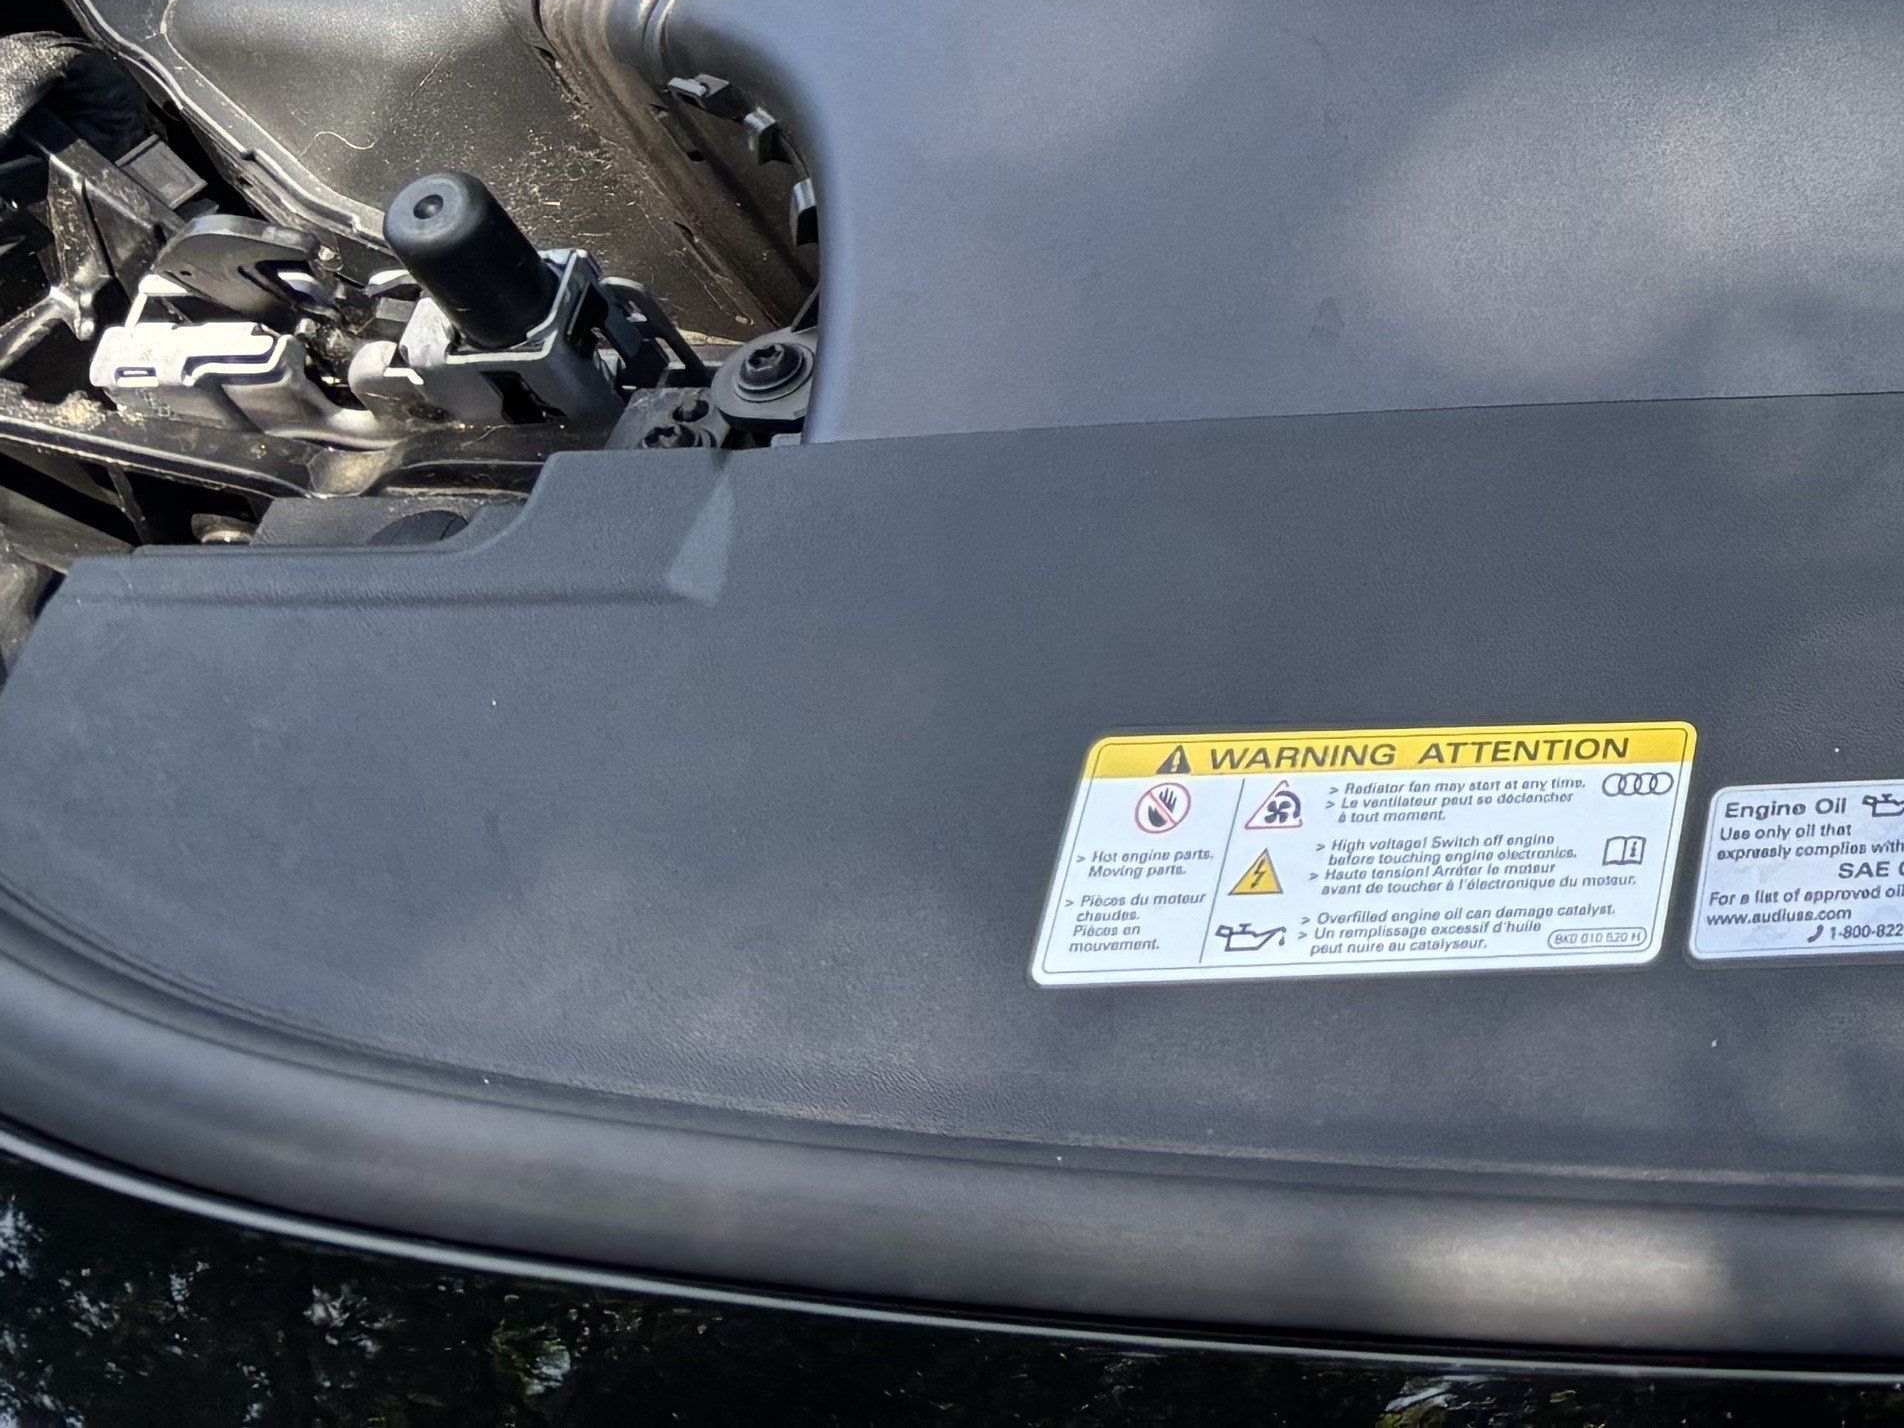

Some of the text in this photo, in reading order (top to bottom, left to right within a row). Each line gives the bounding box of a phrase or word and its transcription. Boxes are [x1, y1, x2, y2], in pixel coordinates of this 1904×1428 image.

[1210, 737, 1629, 769] WARNING ATTENTION
[1344, 776, 1585, 794] Radiator fan may start at any time.
[1340, 796, 1358, 809] Le
[1363, 795, 1437, 808] ventilateur
[1441, 795, 1473, 808] peut
[1476, 796, 1492, 805] se
[1724, 797, 1846, 820] Engine Oil
[1350, 812, 1379, 823] tout
[1383, 809, 1445, 821] moment.
[1720, 823, 1851, 841] Use only oil that
[1331, 838, 1365, 853] High
[1431, 835, 1479, 848] Switch
[1483, 834, 1503, 846] off
[1506, 834, 1554, 848] engine
[1717, 838, 1904, 862] expressly complies with
[1091, 849, 1213, 864] Hot engine parts.
[1327, 846, 1576, 866] before touching engine electronics.
[1088, 865, 1186, 879] Moving parts.
[1324, 868, 1367, 880] Haute
[1487, 862, 1499, 875] le
[1504, 863, 1555, 874] moteur
[1838, 860, 1890, 879] SAE
[1321, 883, 1361, 895] avant
[1365, 881, 1383, 894] de
[1387, 879, 1442, 893] toucher
[1559, 875, 1578, 887] du
[1582, 875, 1636, 886] moteur.
[1080, 893, 1206, 907] Pièces du moteur
[1709, 891, 1736, 907] For
[1755, 890, 1779, 903] list
[1783, 887, 1800, 903] of
[1803, 885, 1881, 904] approved
[1076, 909, 1139, 922] chaudes.
[1317, 903, 1615, 925] Overfilled engine oil can damage catalyst.
[1706, 908, 1851, 925] www.audiusa.com
[1072, 924, 1140, 936] Pièces en
[1314, 927, 1335, 939] Un
[1339, 923, 1427, 940] remplissage
[1430, 920, 1490, 935] excessif
[1580, 932, 1603, 943] 010
[1068, 938, 1159, 953] mouvement.
[1309, 938, 1487, 956] peut nuire au catalyseur.
